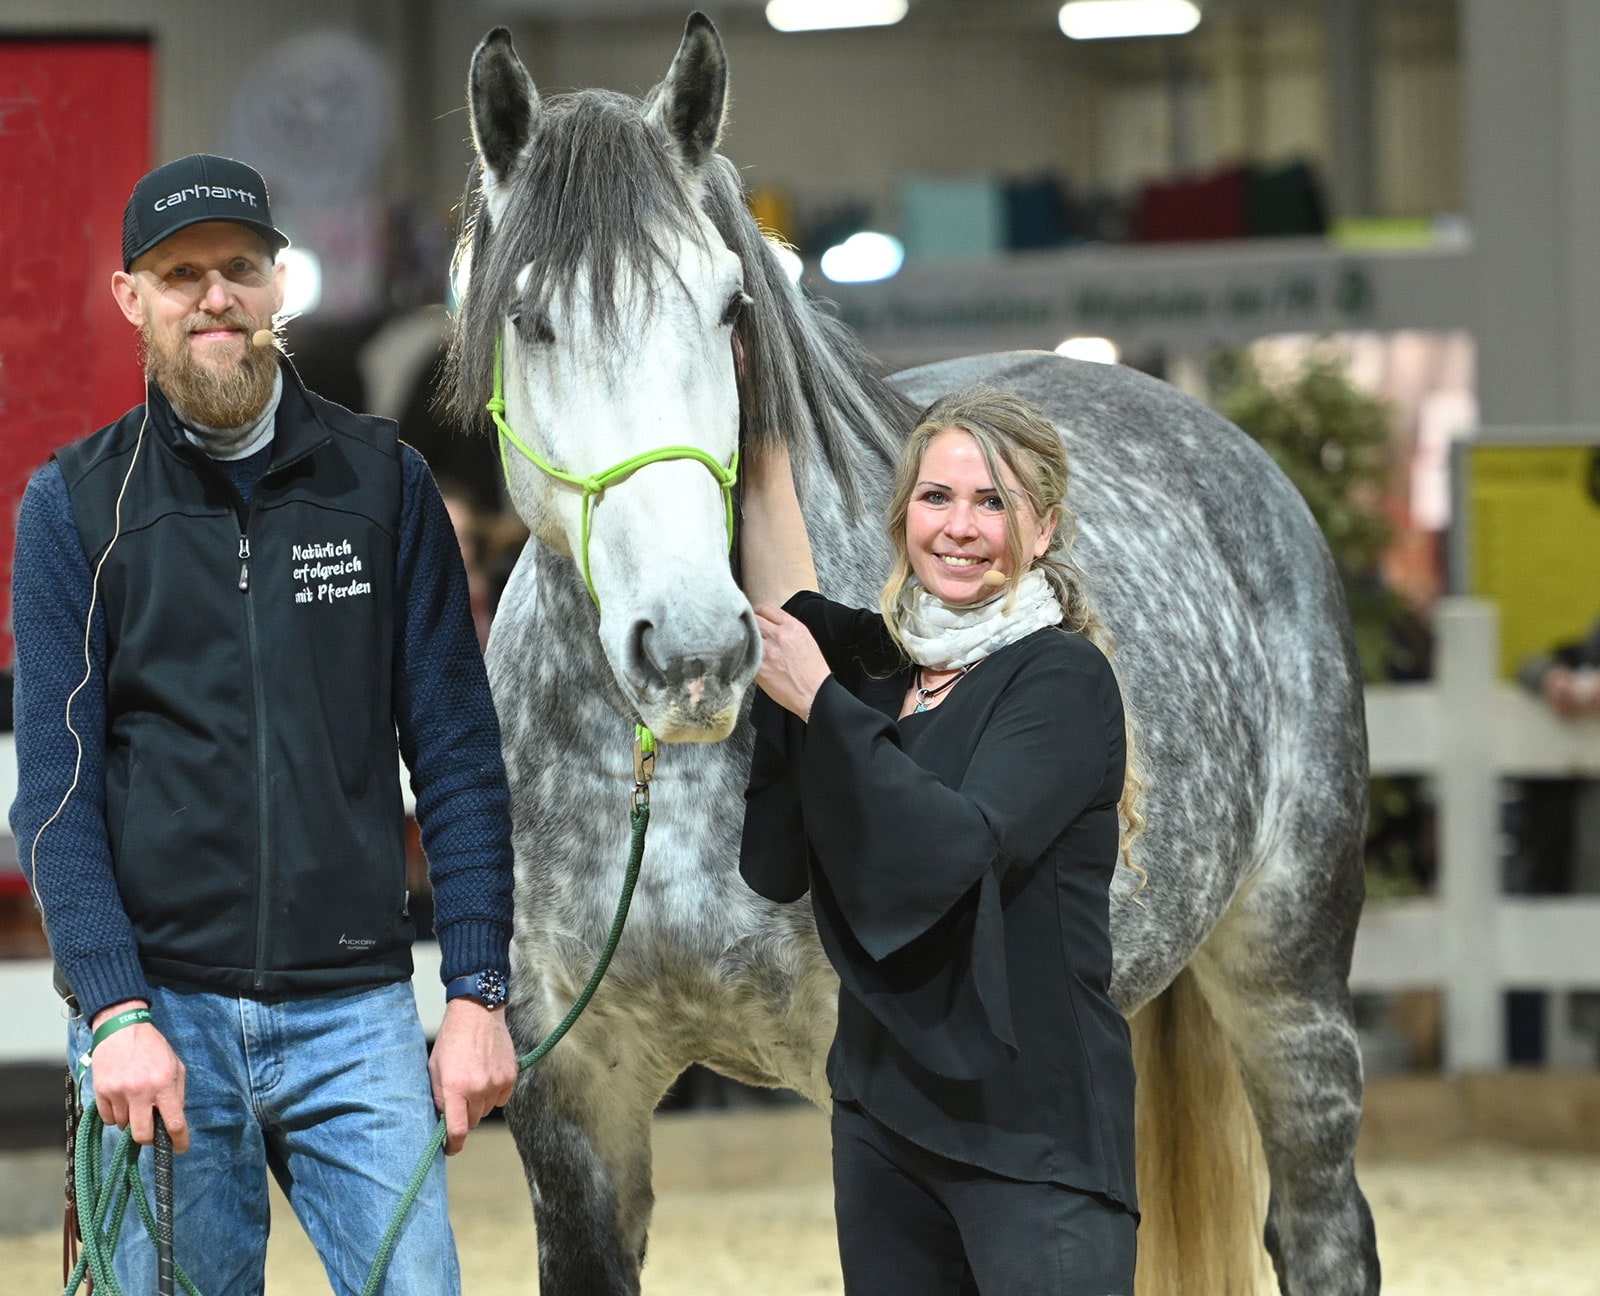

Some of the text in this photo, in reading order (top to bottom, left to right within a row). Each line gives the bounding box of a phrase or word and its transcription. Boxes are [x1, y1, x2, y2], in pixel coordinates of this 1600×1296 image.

[154, 184, 257, 212] carhartt
[292, 539, 352, 561] Natürlich
[293, 555, 362, 584] erfolgreich
[295, 579, 371, 604] mit Pferden
